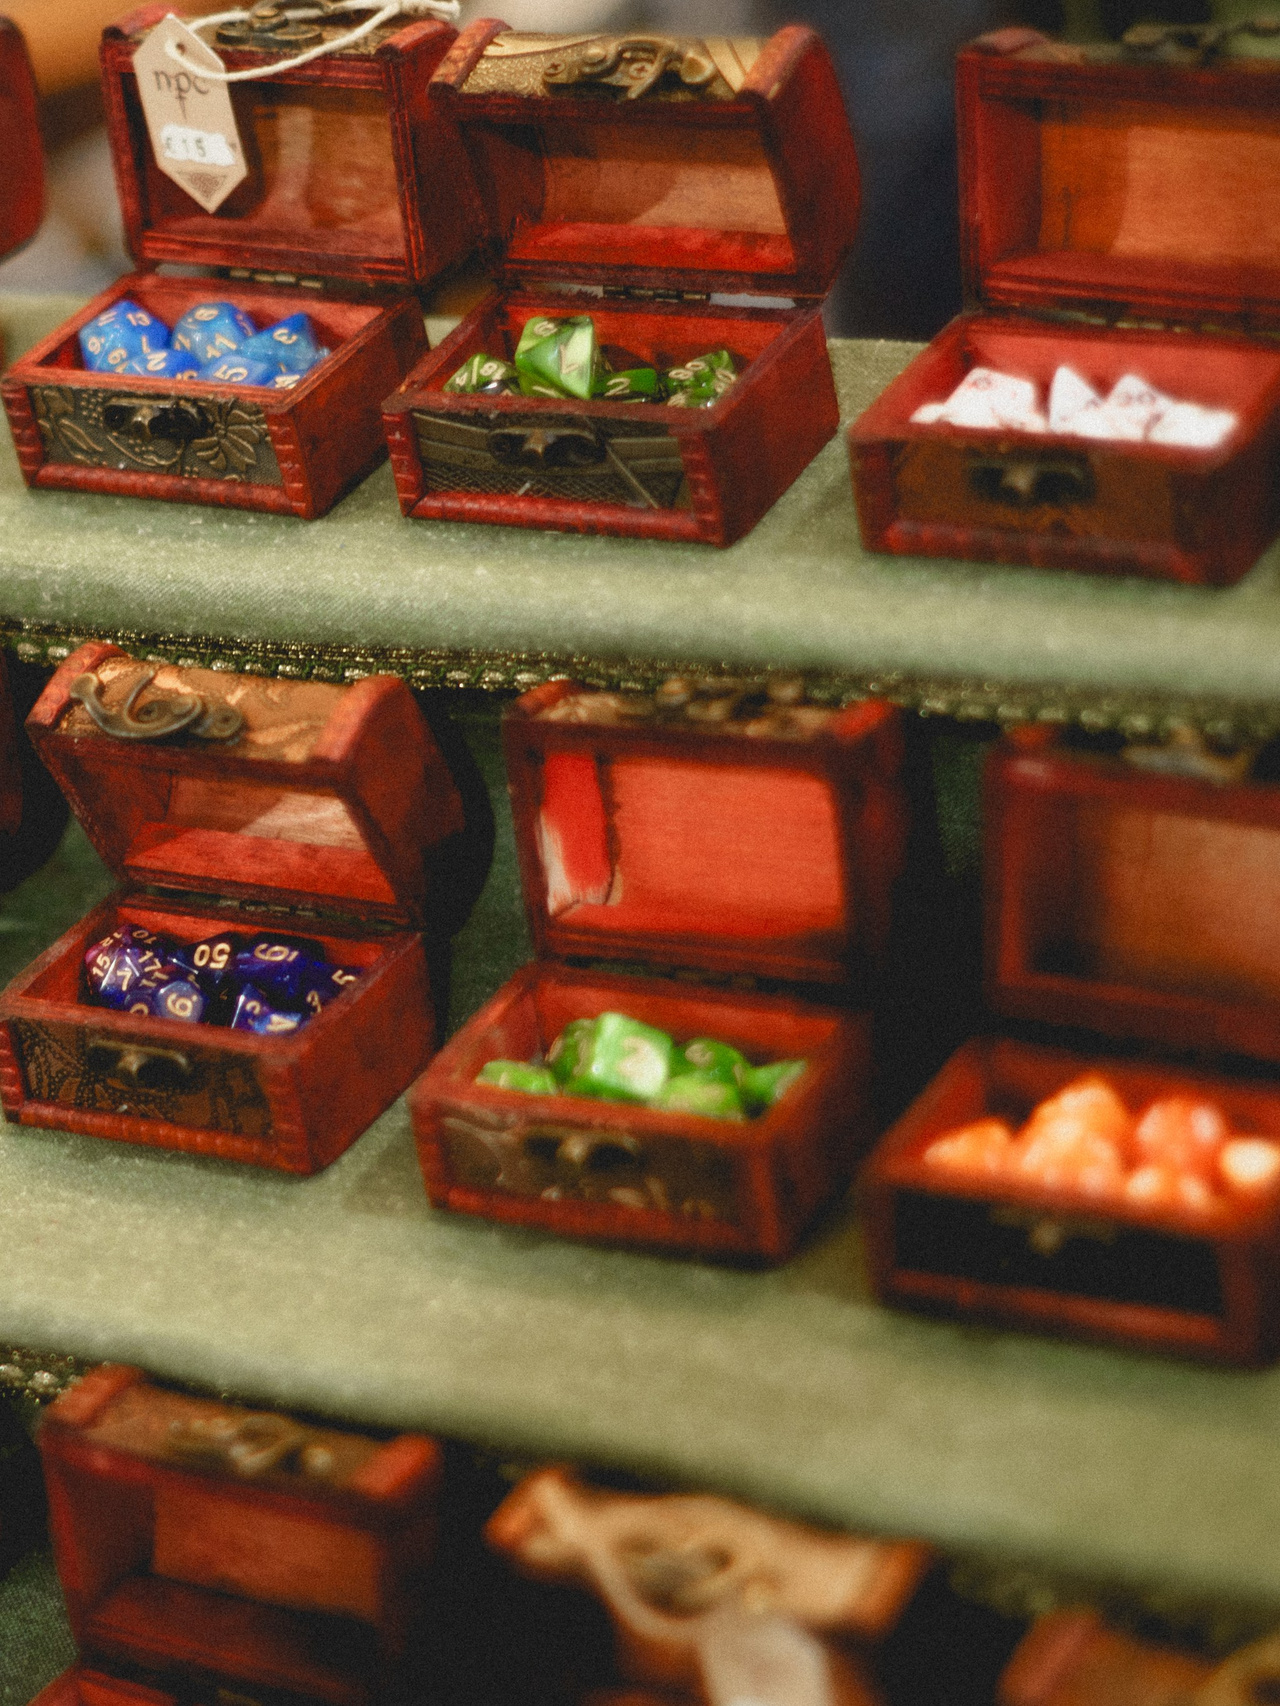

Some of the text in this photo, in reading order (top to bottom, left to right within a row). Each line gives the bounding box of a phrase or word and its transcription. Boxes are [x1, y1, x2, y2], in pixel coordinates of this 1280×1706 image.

[153, 70, 210, 120] npc
[91, 953, 112, 978] 15
[138, 950, 162, 972] 17
[193, 943, 231, 969] 50
[116, 967, 133, 992] 7
